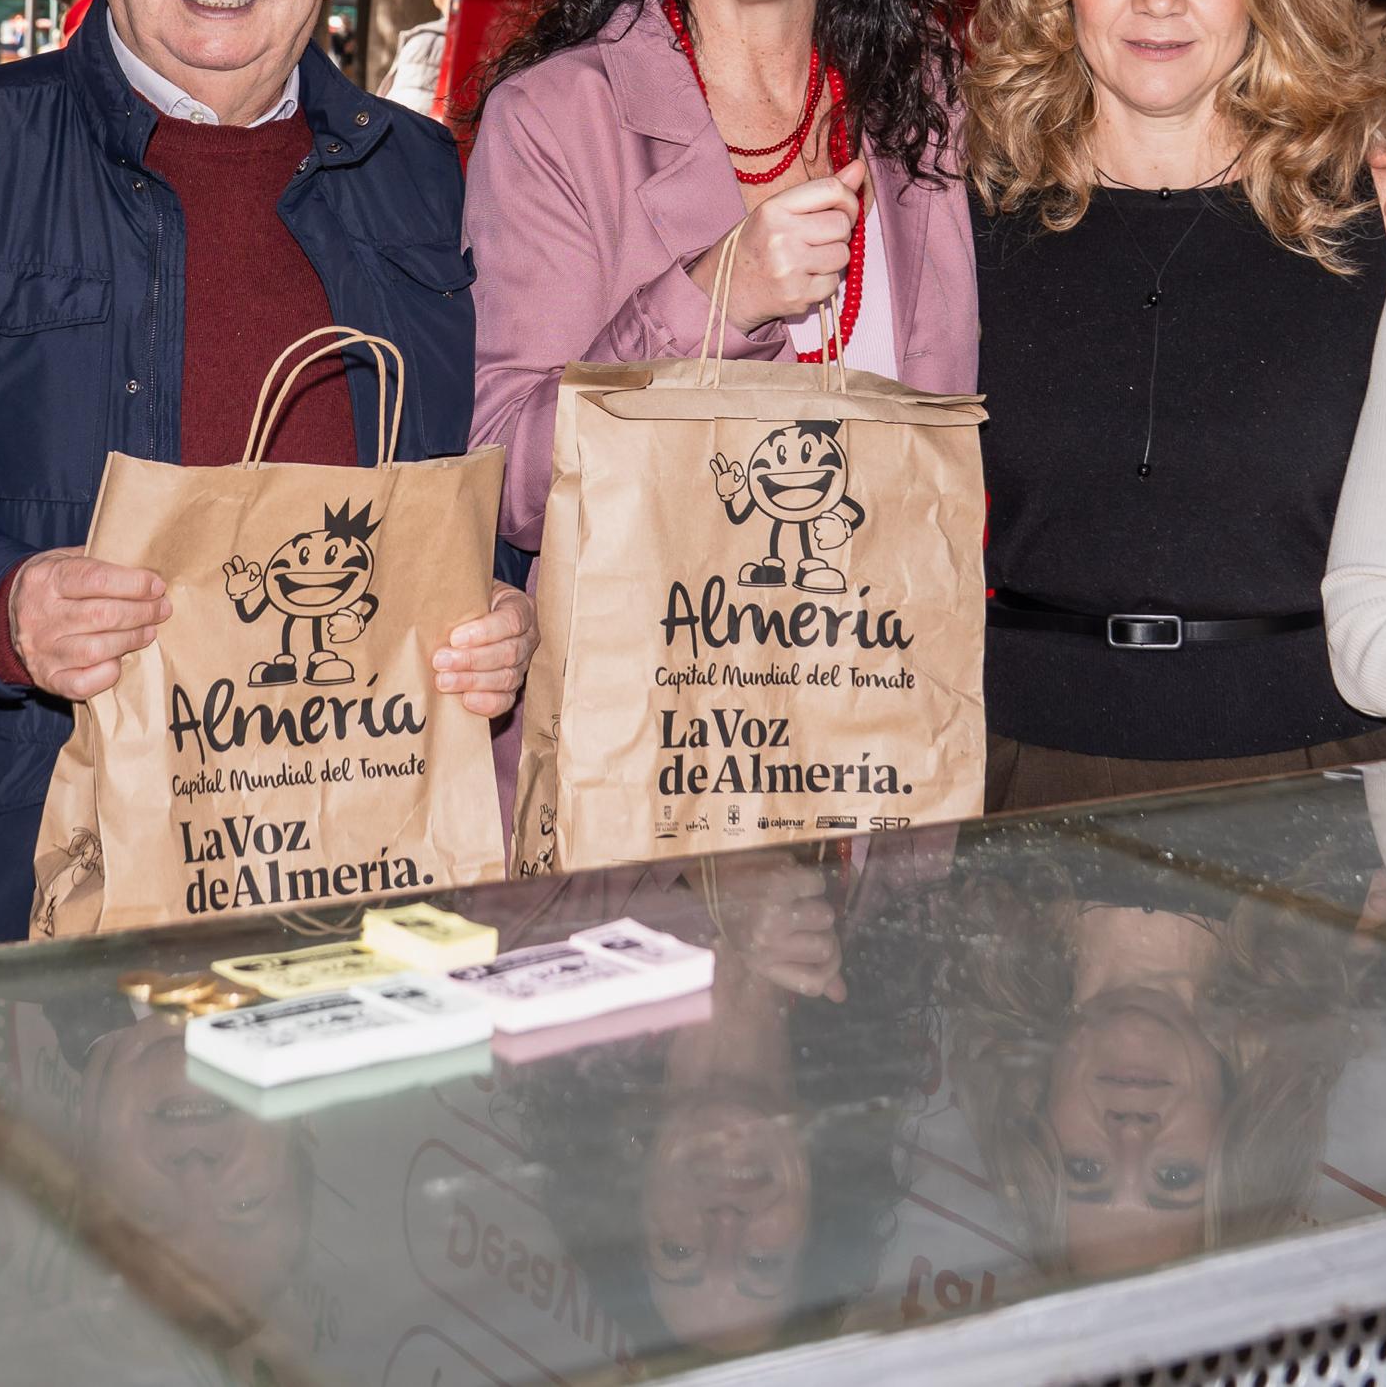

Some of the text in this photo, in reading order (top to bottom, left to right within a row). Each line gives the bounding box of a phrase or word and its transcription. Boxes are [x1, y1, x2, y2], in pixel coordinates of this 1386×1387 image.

[660, 575, 914, 659] Almería
[655, 662, 916, 695] Capital Mundial del Tomate
[169, 672, 427, 765] Almería
[172, 752, 426, 804] Capital Mundial del Tomate
